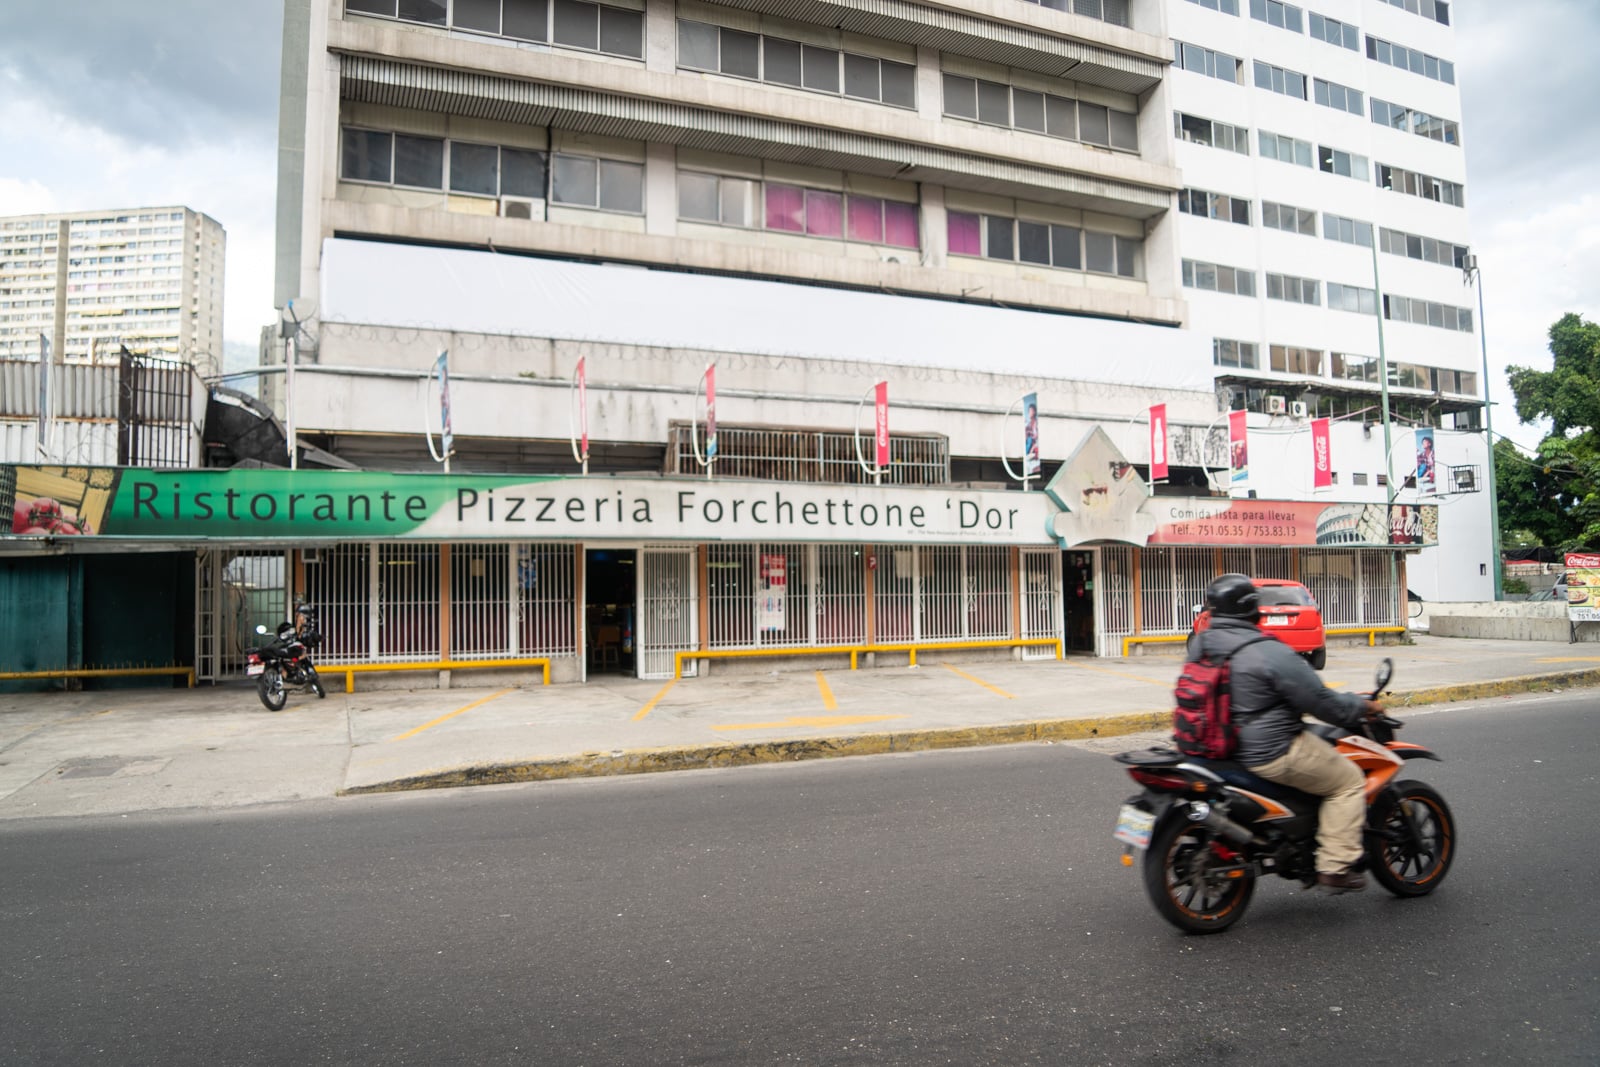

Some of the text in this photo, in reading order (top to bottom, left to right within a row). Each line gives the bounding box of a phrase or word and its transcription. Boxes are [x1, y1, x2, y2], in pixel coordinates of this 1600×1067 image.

[133, 481, 428, 521] Ristorante
[457, 488, 653, 522] Pizzeria
[678, 491, 926, 527] Forchettone
[1170, 507, 1296, 521] Comida lista para llevar
[1198, 525, 1243, 536] 751.05.35
[1253, 526, 1297, 537] 753.83.13
